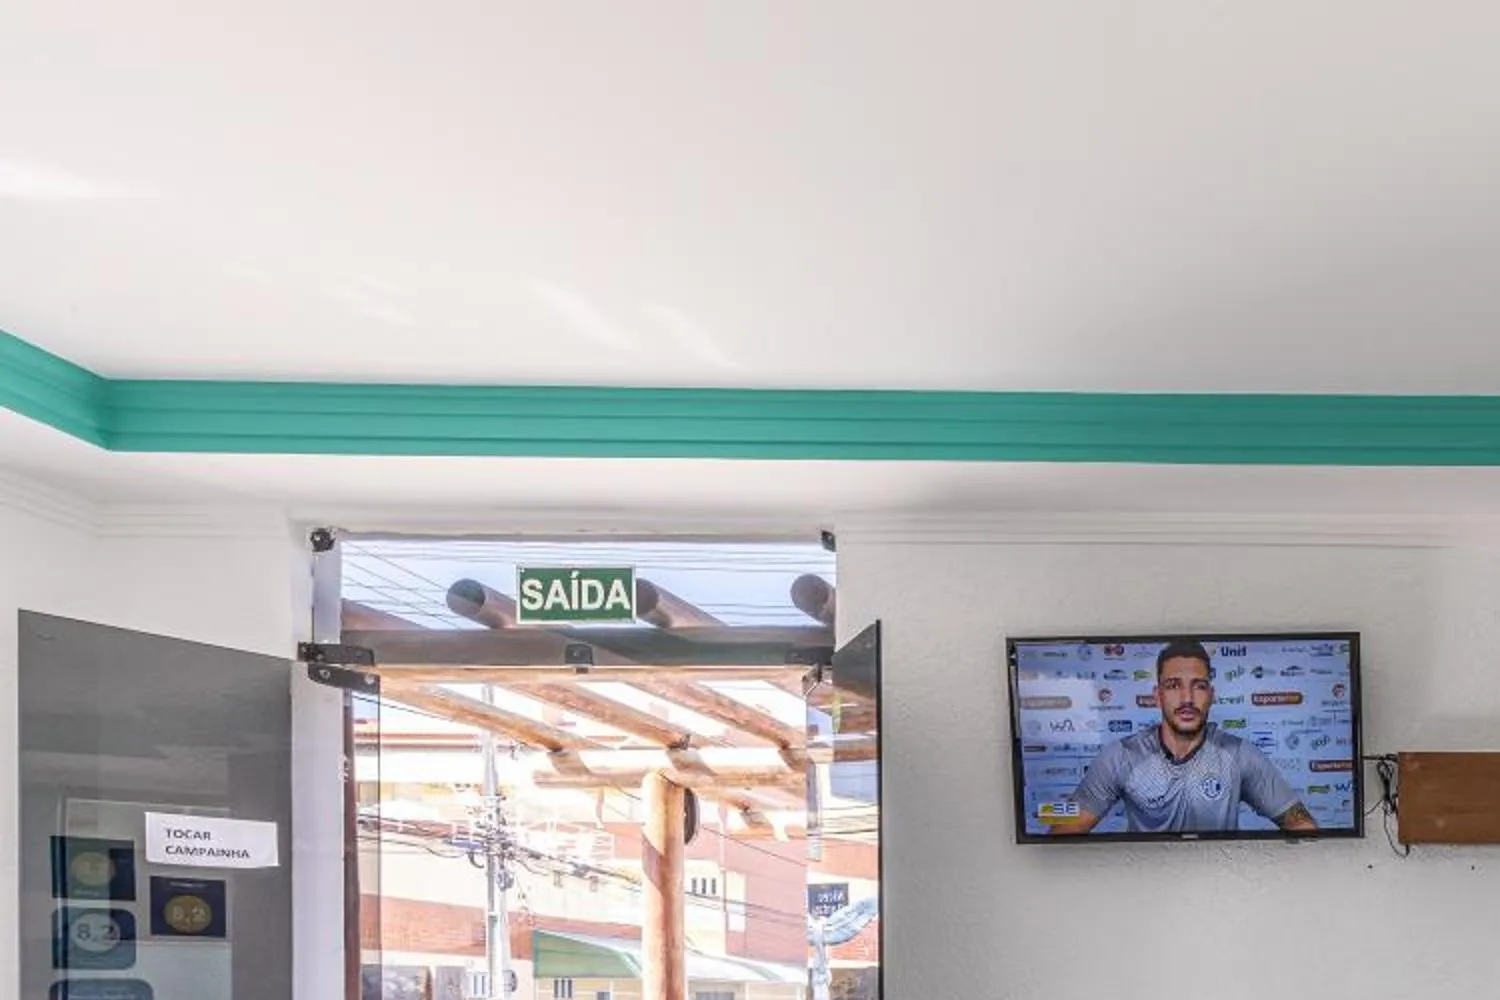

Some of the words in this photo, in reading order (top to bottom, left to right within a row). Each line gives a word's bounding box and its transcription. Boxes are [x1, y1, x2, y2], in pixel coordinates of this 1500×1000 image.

[521, 570, 632, 611] SAÍDA
[166, 828, 211, 840] TOCAR
[165, 845, 250, 858] CAMPAINHA
